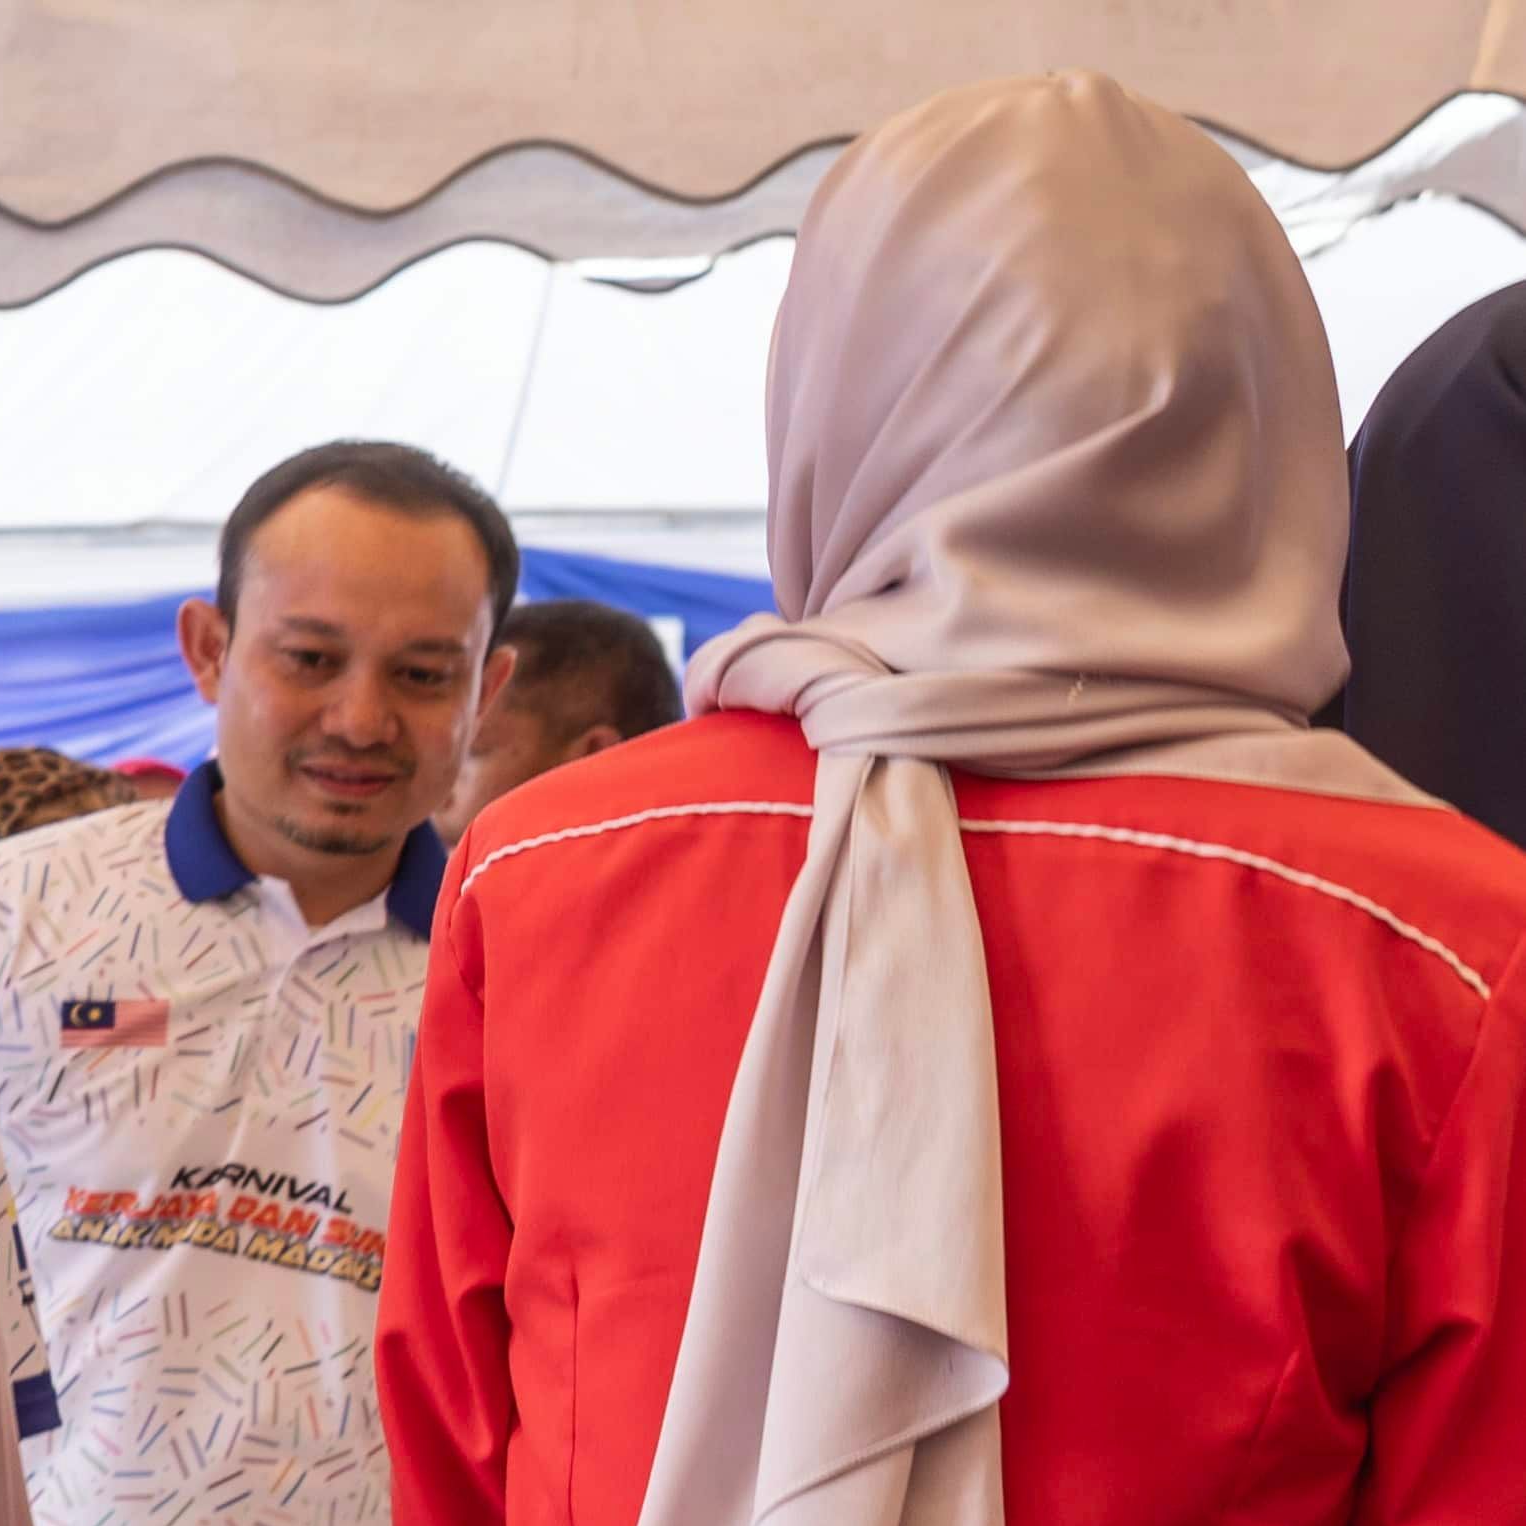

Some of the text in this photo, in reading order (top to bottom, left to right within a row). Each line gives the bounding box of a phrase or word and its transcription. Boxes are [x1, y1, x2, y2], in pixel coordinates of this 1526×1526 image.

[65, 1185, 218, 1220] KERJAYA
[226, 1195, 318, 1238] DAN
[170, 1163, 352, 1213] KARNIVAL
